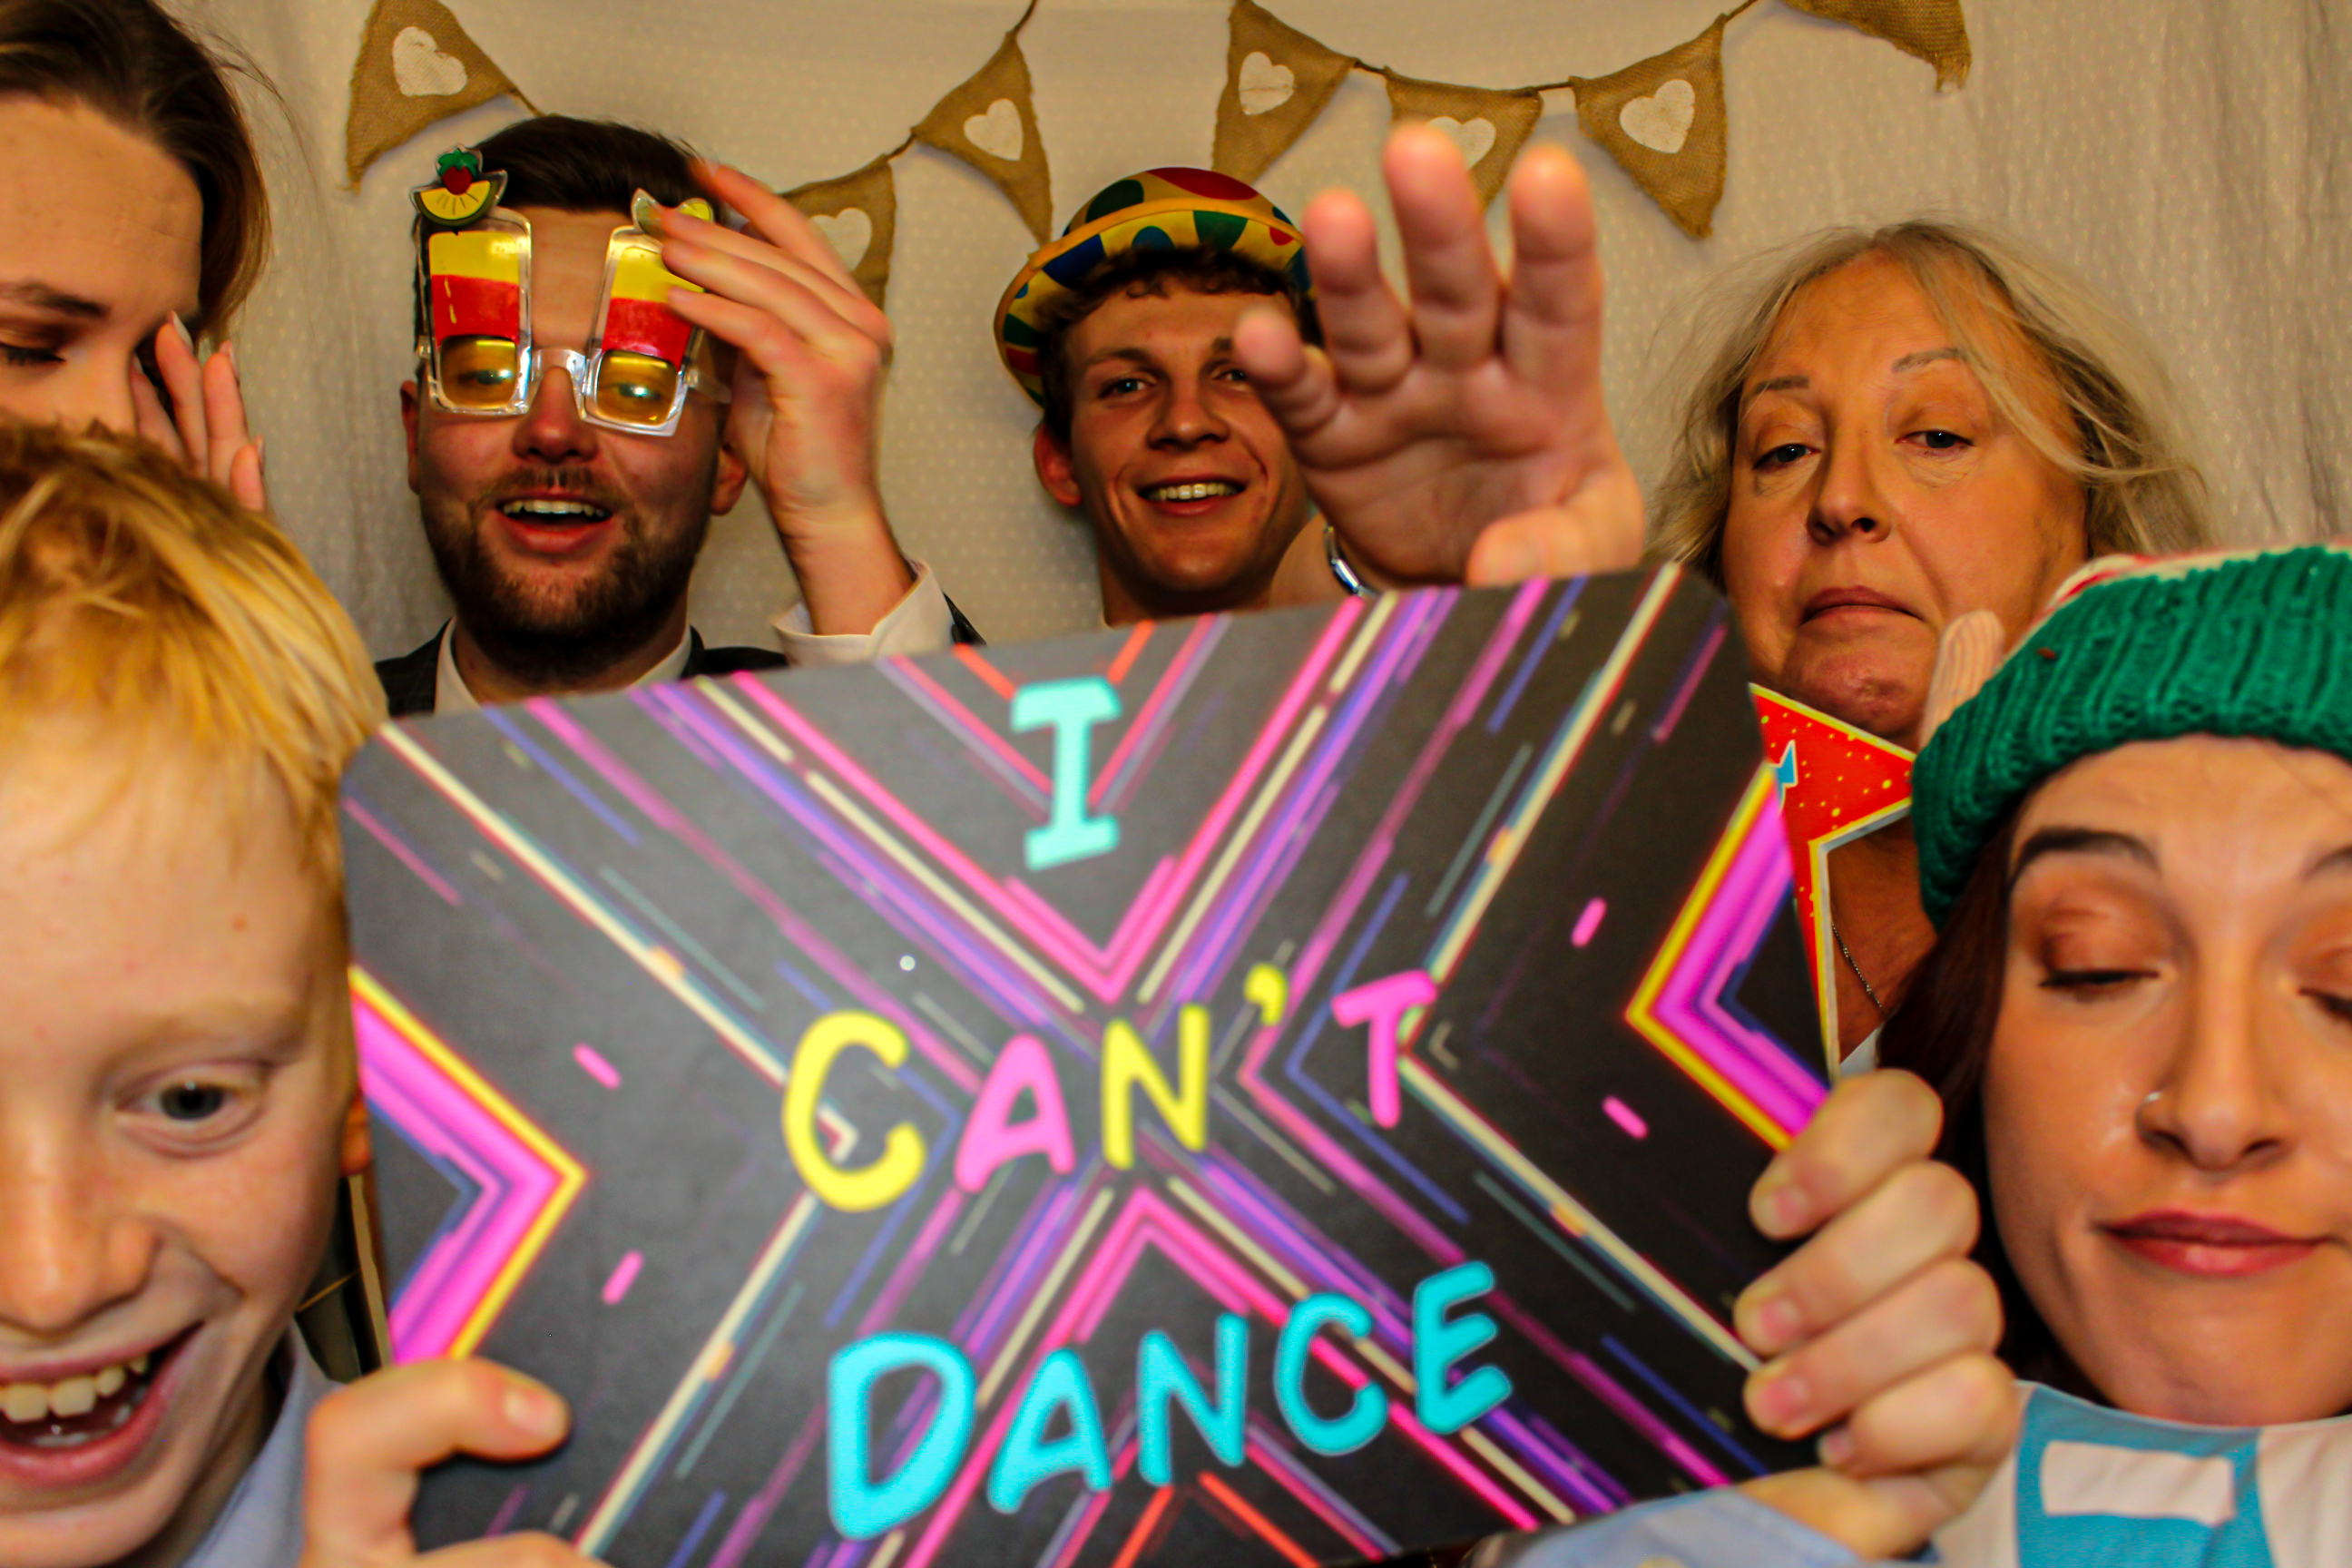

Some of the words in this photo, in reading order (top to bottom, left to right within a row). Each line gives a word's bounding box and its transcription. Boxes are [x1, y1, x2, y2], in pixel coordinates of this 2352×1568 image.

[1010, 675, 1122, 871] I
[782, 964, 1438, 1213] CAN'T
[827, 1259, 1513, 1542] DANCE
